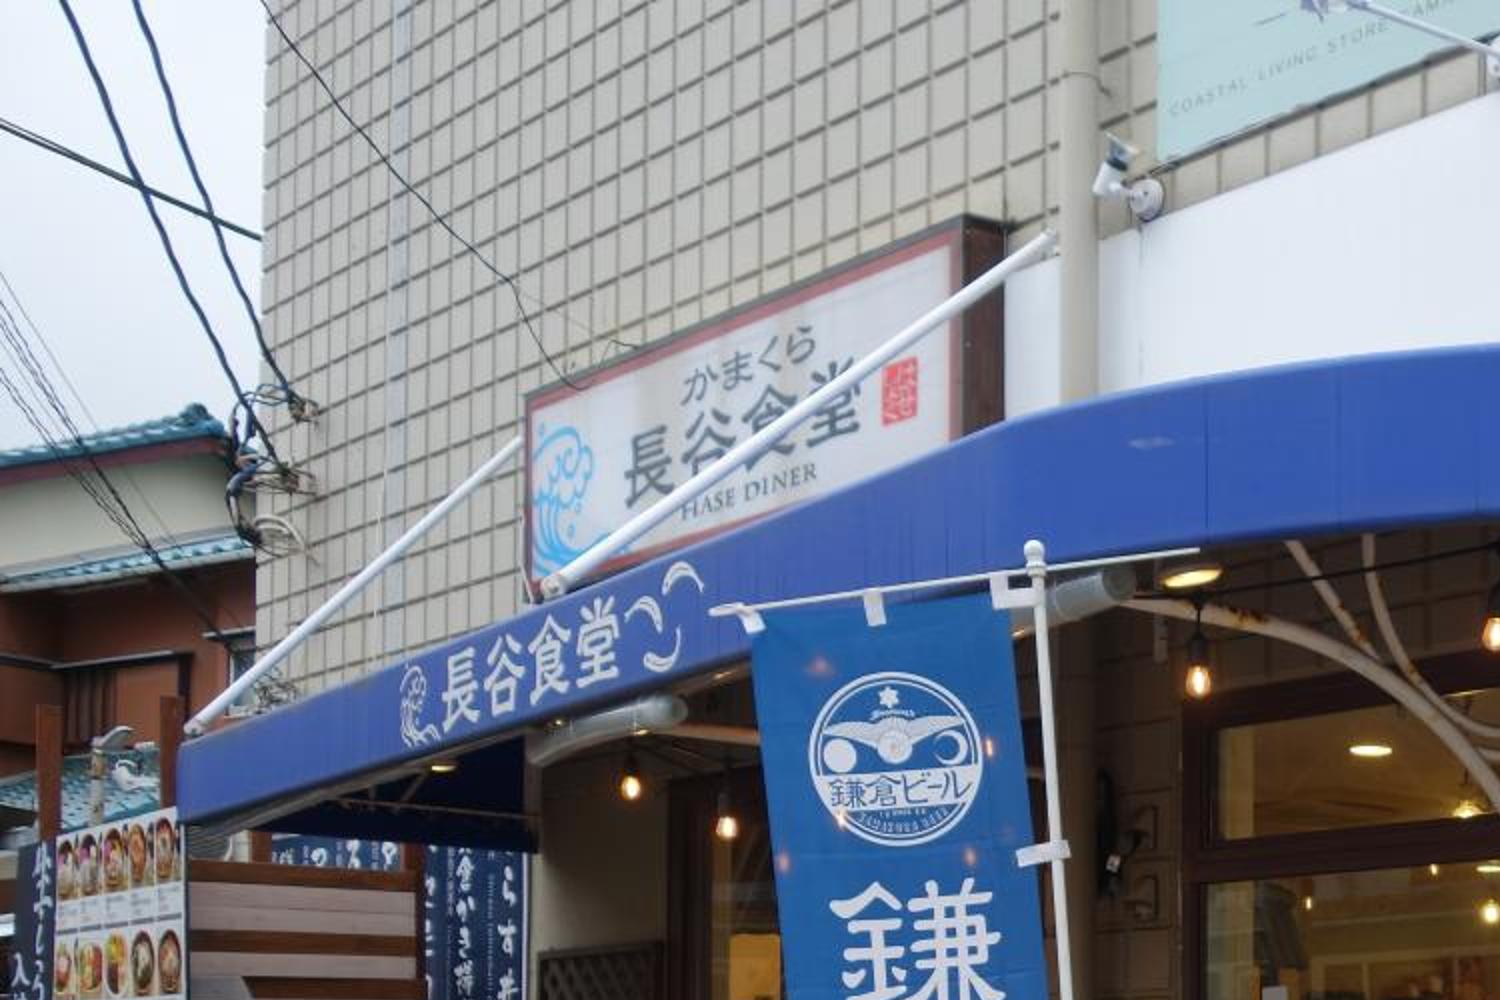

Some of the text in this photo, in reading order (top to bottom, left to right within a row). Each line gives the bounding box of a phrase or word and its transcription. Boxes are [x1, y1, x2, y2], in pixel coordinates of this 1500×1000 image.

[681, 325, 817, 406] かまくら
[624, 356, 862, 508] 長谷食堂
[679, 462, 818, 522] HASE DINER
[441, 596, 621, 733] 長谷食堂
[830, 769, 973, 809] 鎌倉ビール
